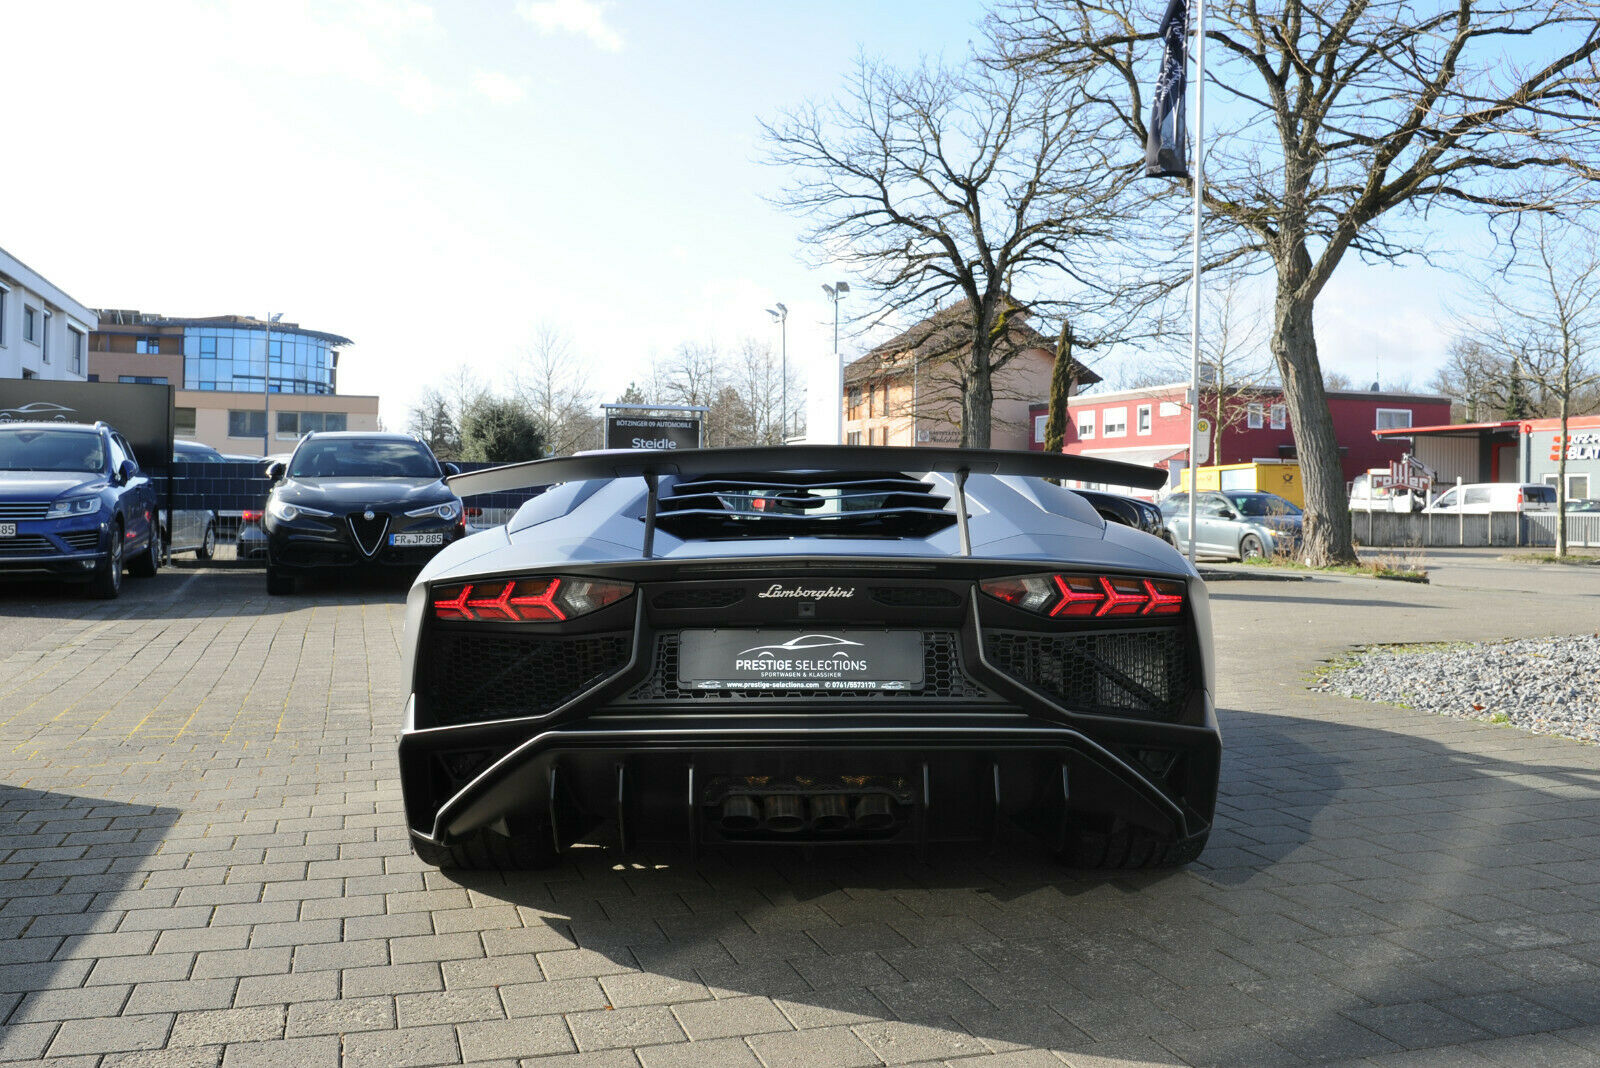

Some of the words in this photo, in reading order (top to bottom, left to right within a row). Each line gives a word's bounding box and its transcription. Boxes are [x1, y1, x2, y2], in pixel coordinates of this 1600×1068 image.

[631, 438, 677, 449] Steidle
[394, 535, 407, 544] FR
[758, 584, 855, 600] Lamborghini
[736, 660, 793, 670] PRESTIGE
[795, 660, 867, 670] SELECTIONS
